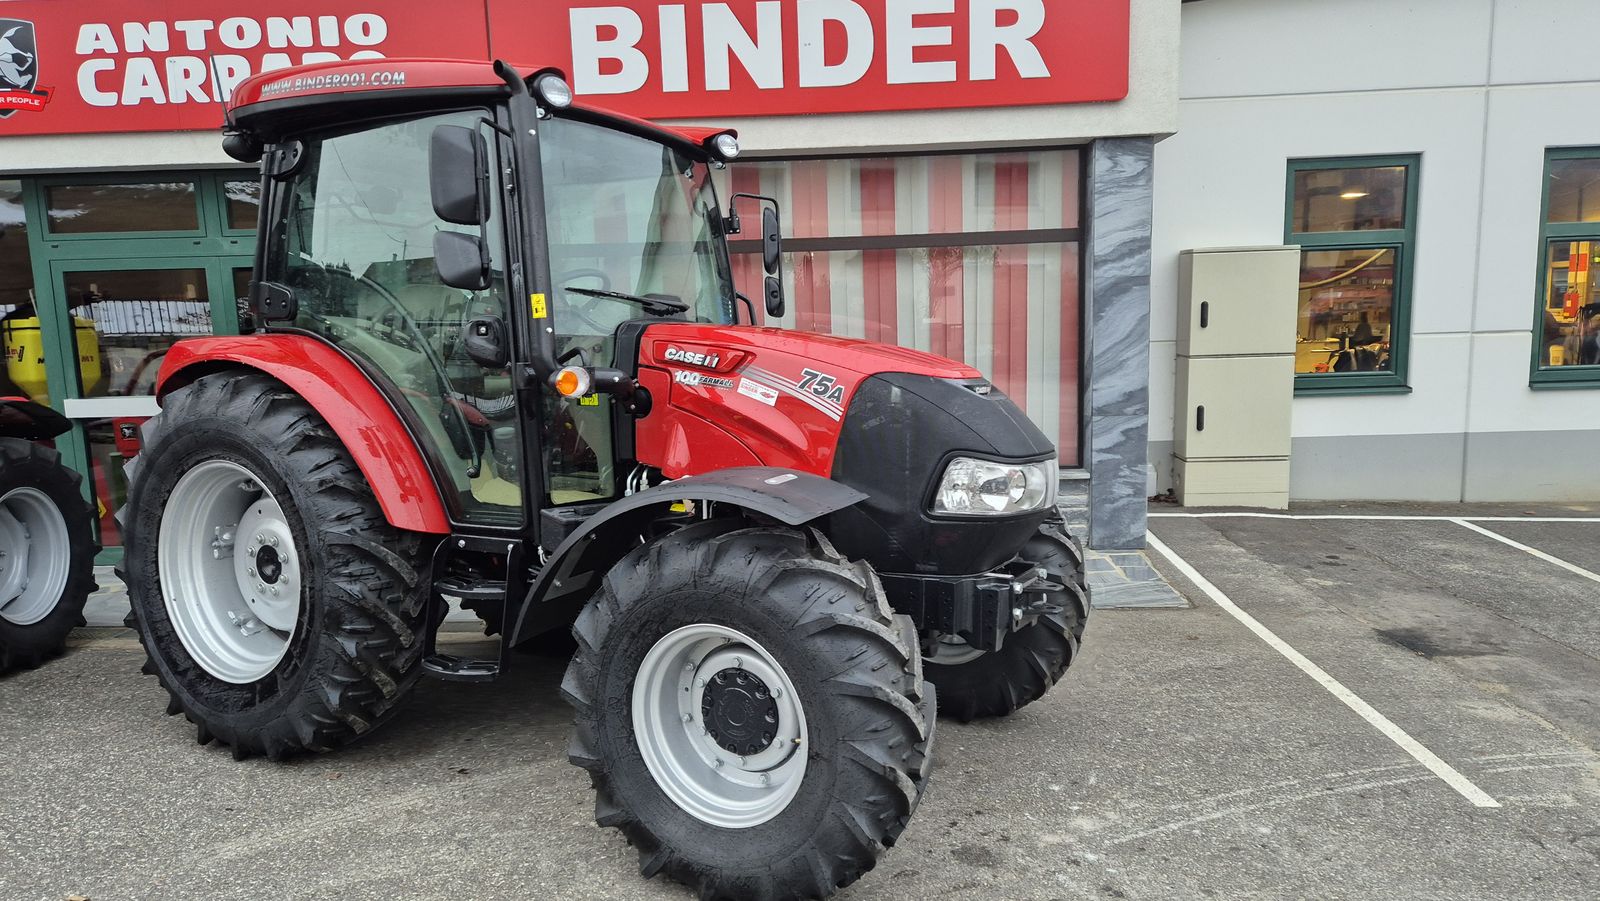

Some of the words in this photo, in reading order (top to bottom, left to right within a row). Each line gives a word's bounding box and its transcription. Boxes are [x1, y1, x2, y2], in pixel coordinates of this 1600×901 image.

[76, 14, 388, 54] ANTONIO
[569, 0, 1051, 95] BINDER
[77, 51, 384, 106] CARR
[261, 71, 406, 97] WWW.BINDER001.COM
[6, 97, 41, 106] PEOPLE
[664, 348, 705, 365] CASE
[675, 370, 700, 386] 100
[796, 368, 845, 404] 75A
